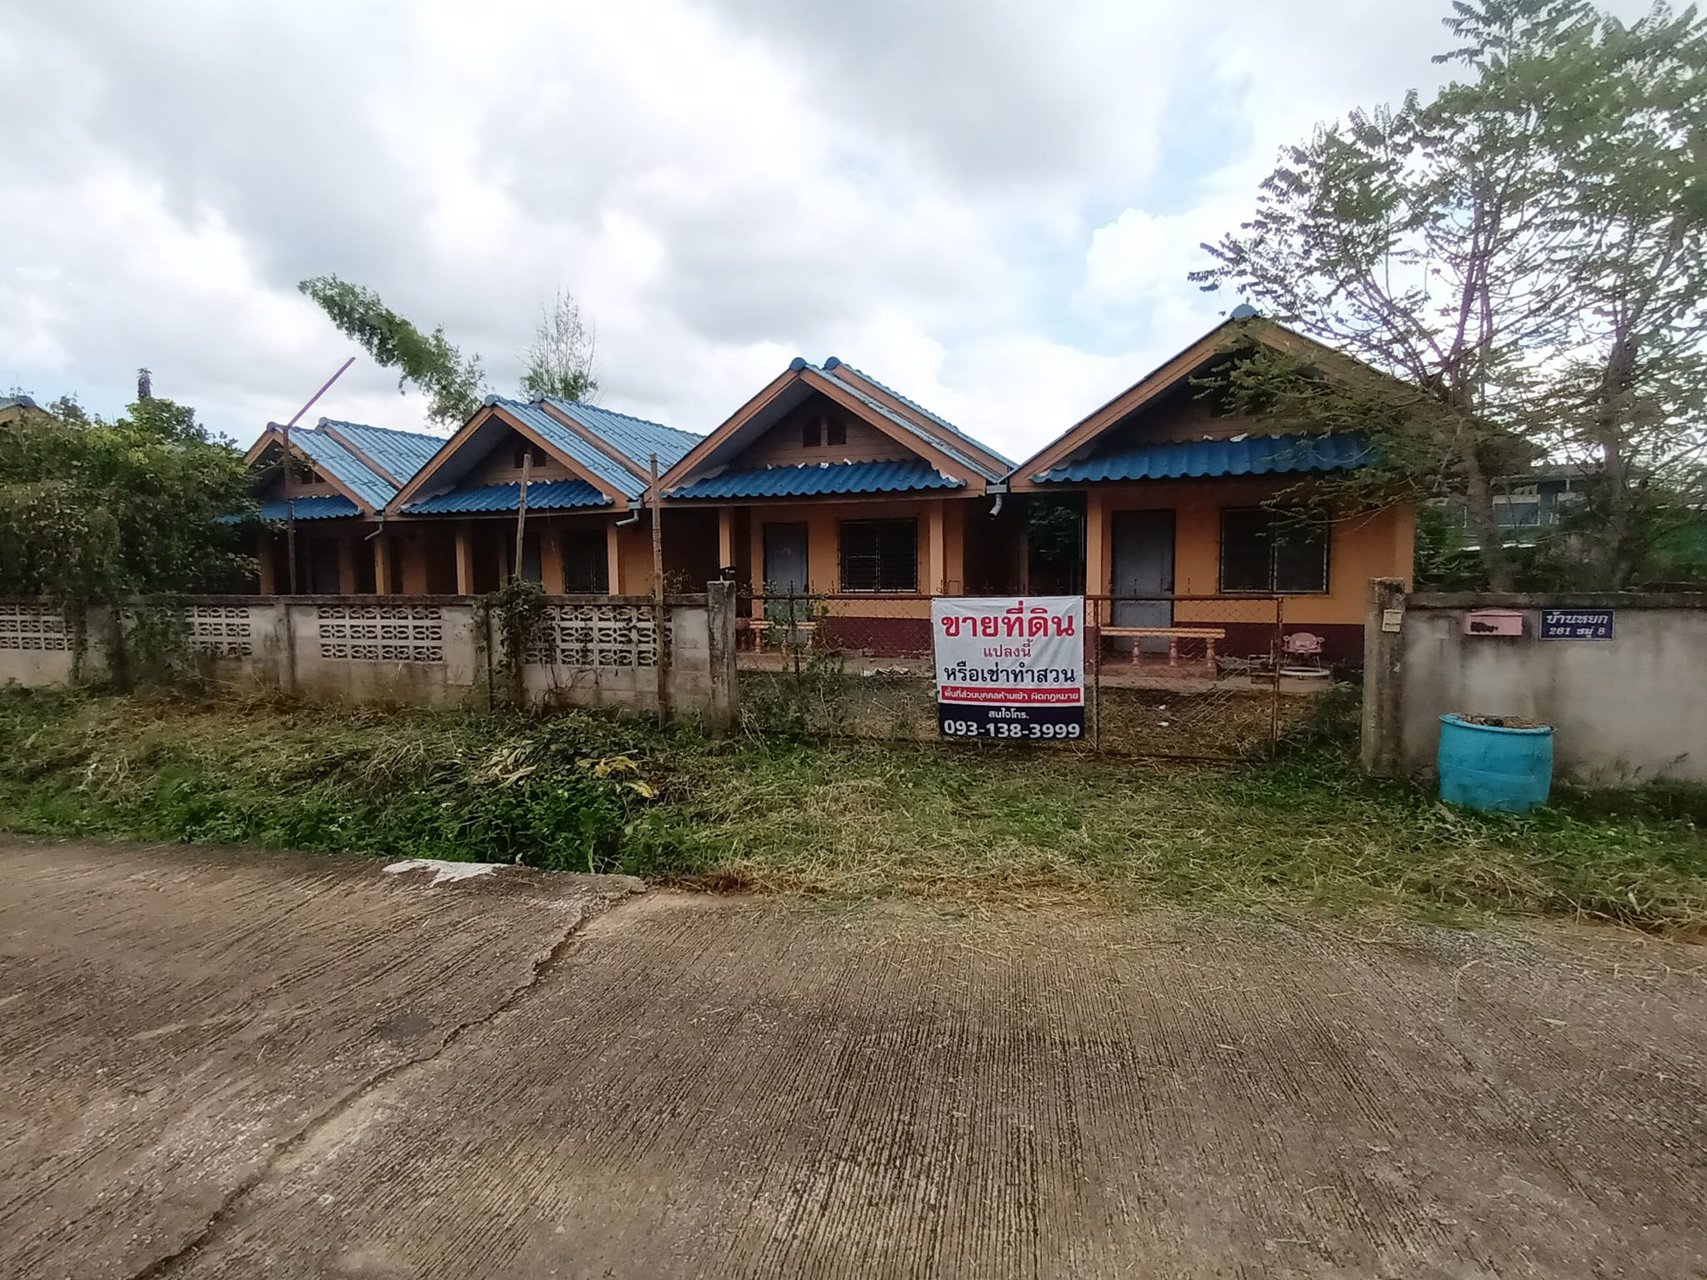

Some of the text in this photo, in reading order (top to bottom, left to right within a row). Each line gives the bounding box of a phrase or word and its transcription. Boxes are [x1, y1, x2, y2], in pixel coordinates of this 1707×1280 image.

[941, 600, 1075, 638] ขายที่ดิน
[983, 639, 1034, 658] แปลงนี้
[944, 661, 1076, 683] หรือเช่าทำสวน
[988, 708, 1030, 719] สนใจโทร.
[943, 720, 1080, 738] 093-138-3999
